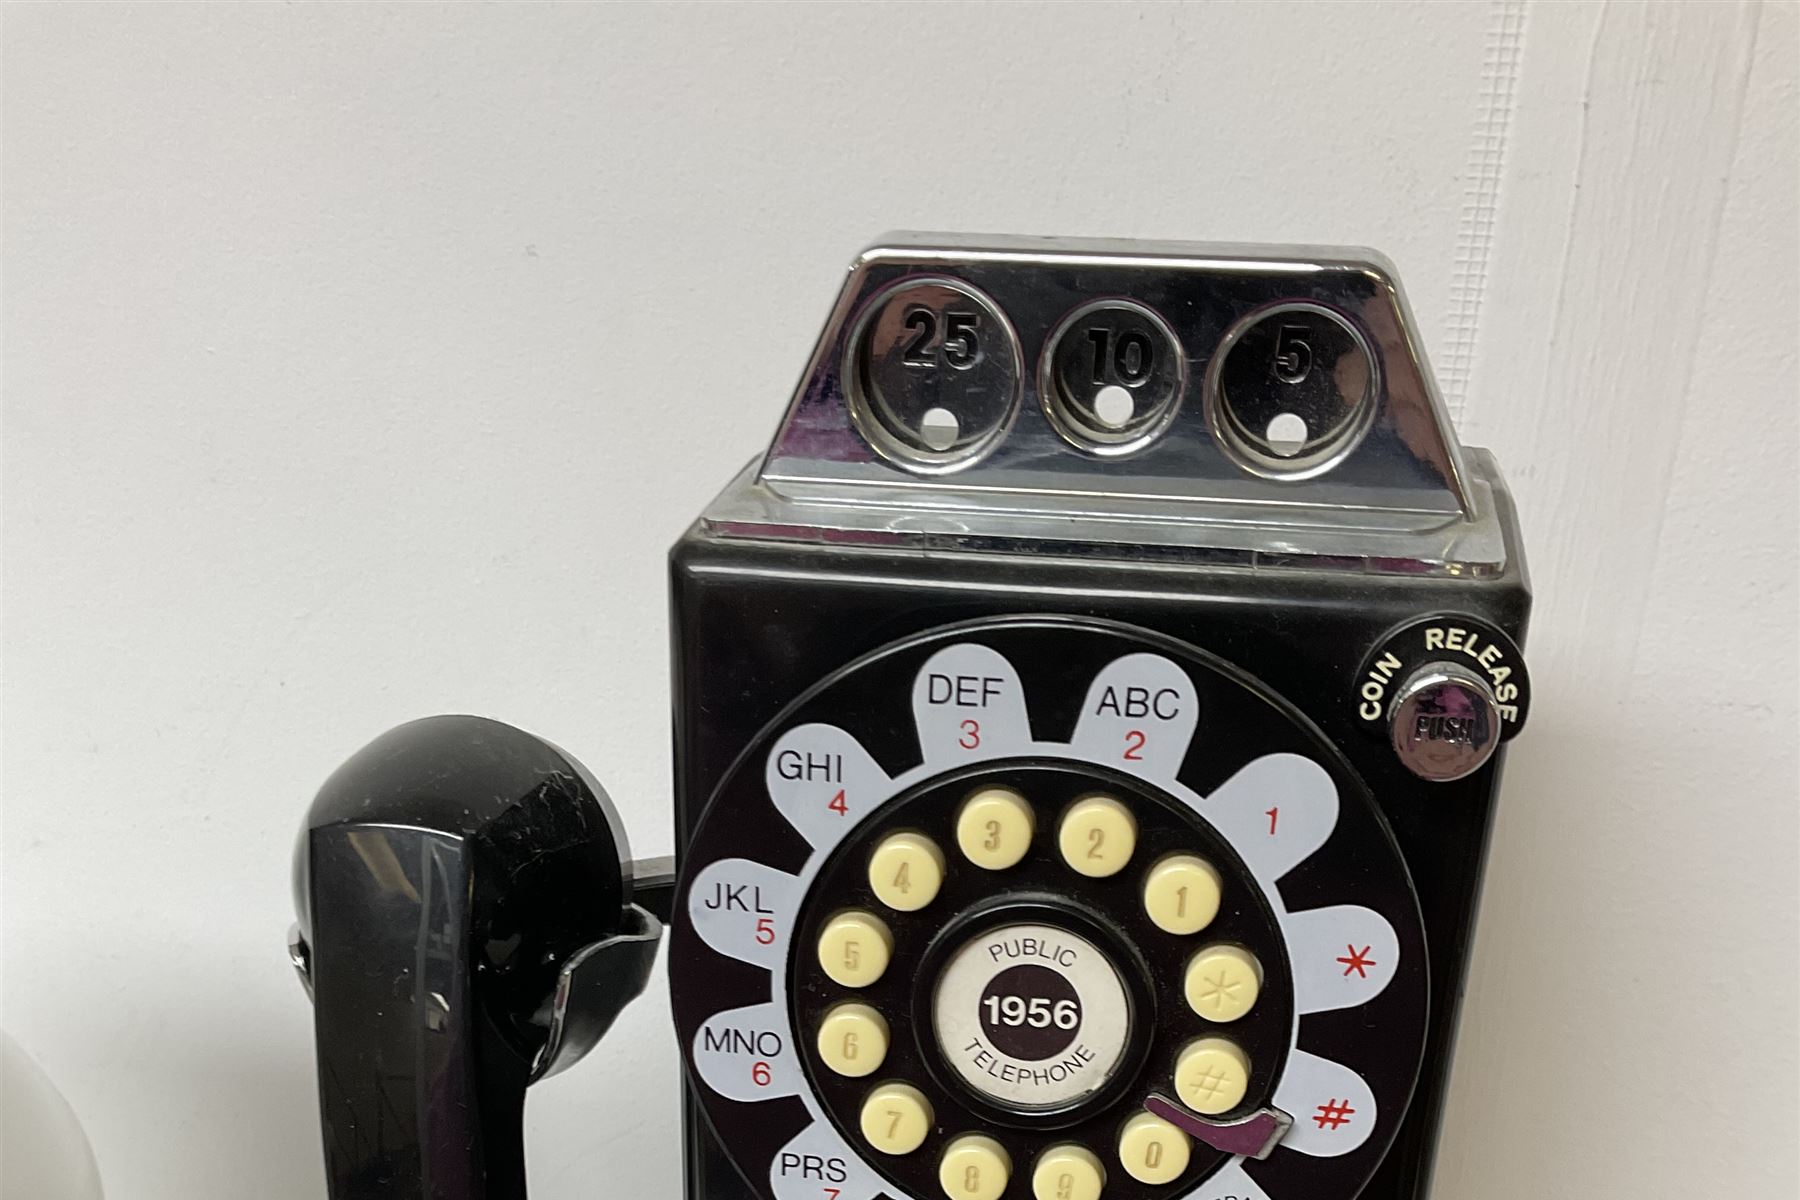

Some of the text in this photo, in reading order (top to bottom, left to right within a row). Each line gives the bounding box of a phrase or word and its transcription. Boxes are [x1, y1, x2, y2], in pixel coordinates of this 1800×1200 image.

[903, 305, 980, 370] 25
[1088, 328, 1154, 388] 10
[1274, 325, 1312, 383] 5
[928, 674, 1004, 707] DEF
[1359, 628, 1519, 722] COIN RELEASE
[1096, 686, 1180, 720] ABC
[959, 719, 980, 749] 3
[1123, 730, 1146, 760] 2
[1414, 717, 1475, 744] PUSH
[777, 750, 842, 783] GHI
[828, 789, 849, 816] 4
[984, 820, 1001, 852] 3
[1265, 807, 1278, 835] 1
[1087, 828, 1104, 860] 2
[893, 862, 911, 894] 4
[705, 883, 774, 914] JKL
[1176, 886, 1189, 918] 1
[756, 919, 775, 945] 5
[844, 941, 859, 970] 5
[988, 938, 1077, 967] PUBLIC
[984, 995, 1078, 1030] 1956
[705, 1026, 782, 1057] MNO
[843, 1032, 858, 1060] 6
[752, 1062, 771, 1086] 6
[964, 1038, 1096, 1086] TELEPHONE
[887, 1110, 903, 1139] 7
[781, 1153, 847, 1183] PRS
[964, 1165, 980, 1193] 8
[1057, 1173, 1074, 1200] 9
